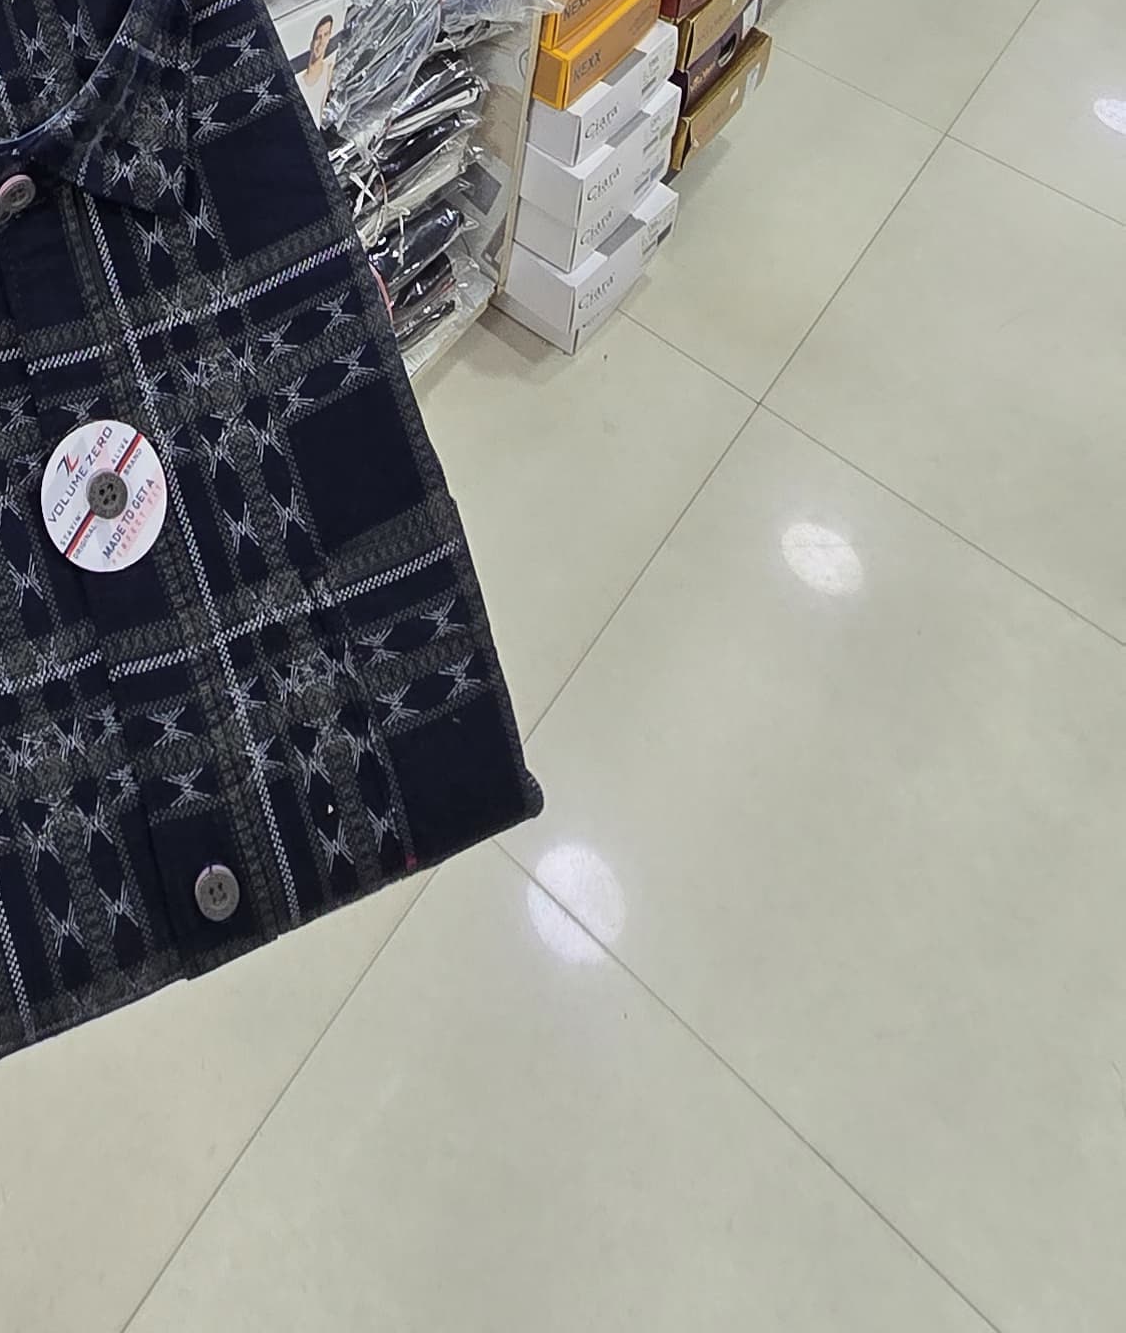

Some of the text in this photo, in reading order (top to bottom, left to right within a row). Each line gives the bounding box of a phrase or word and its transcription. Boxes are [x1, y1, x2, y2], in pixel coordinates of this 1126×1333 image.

[48, 425, 113, 525] VOLUME ZERO
[111, 437, 130, 465] ALIVE
[102, 478, 155, 560] MADE TO GET A
